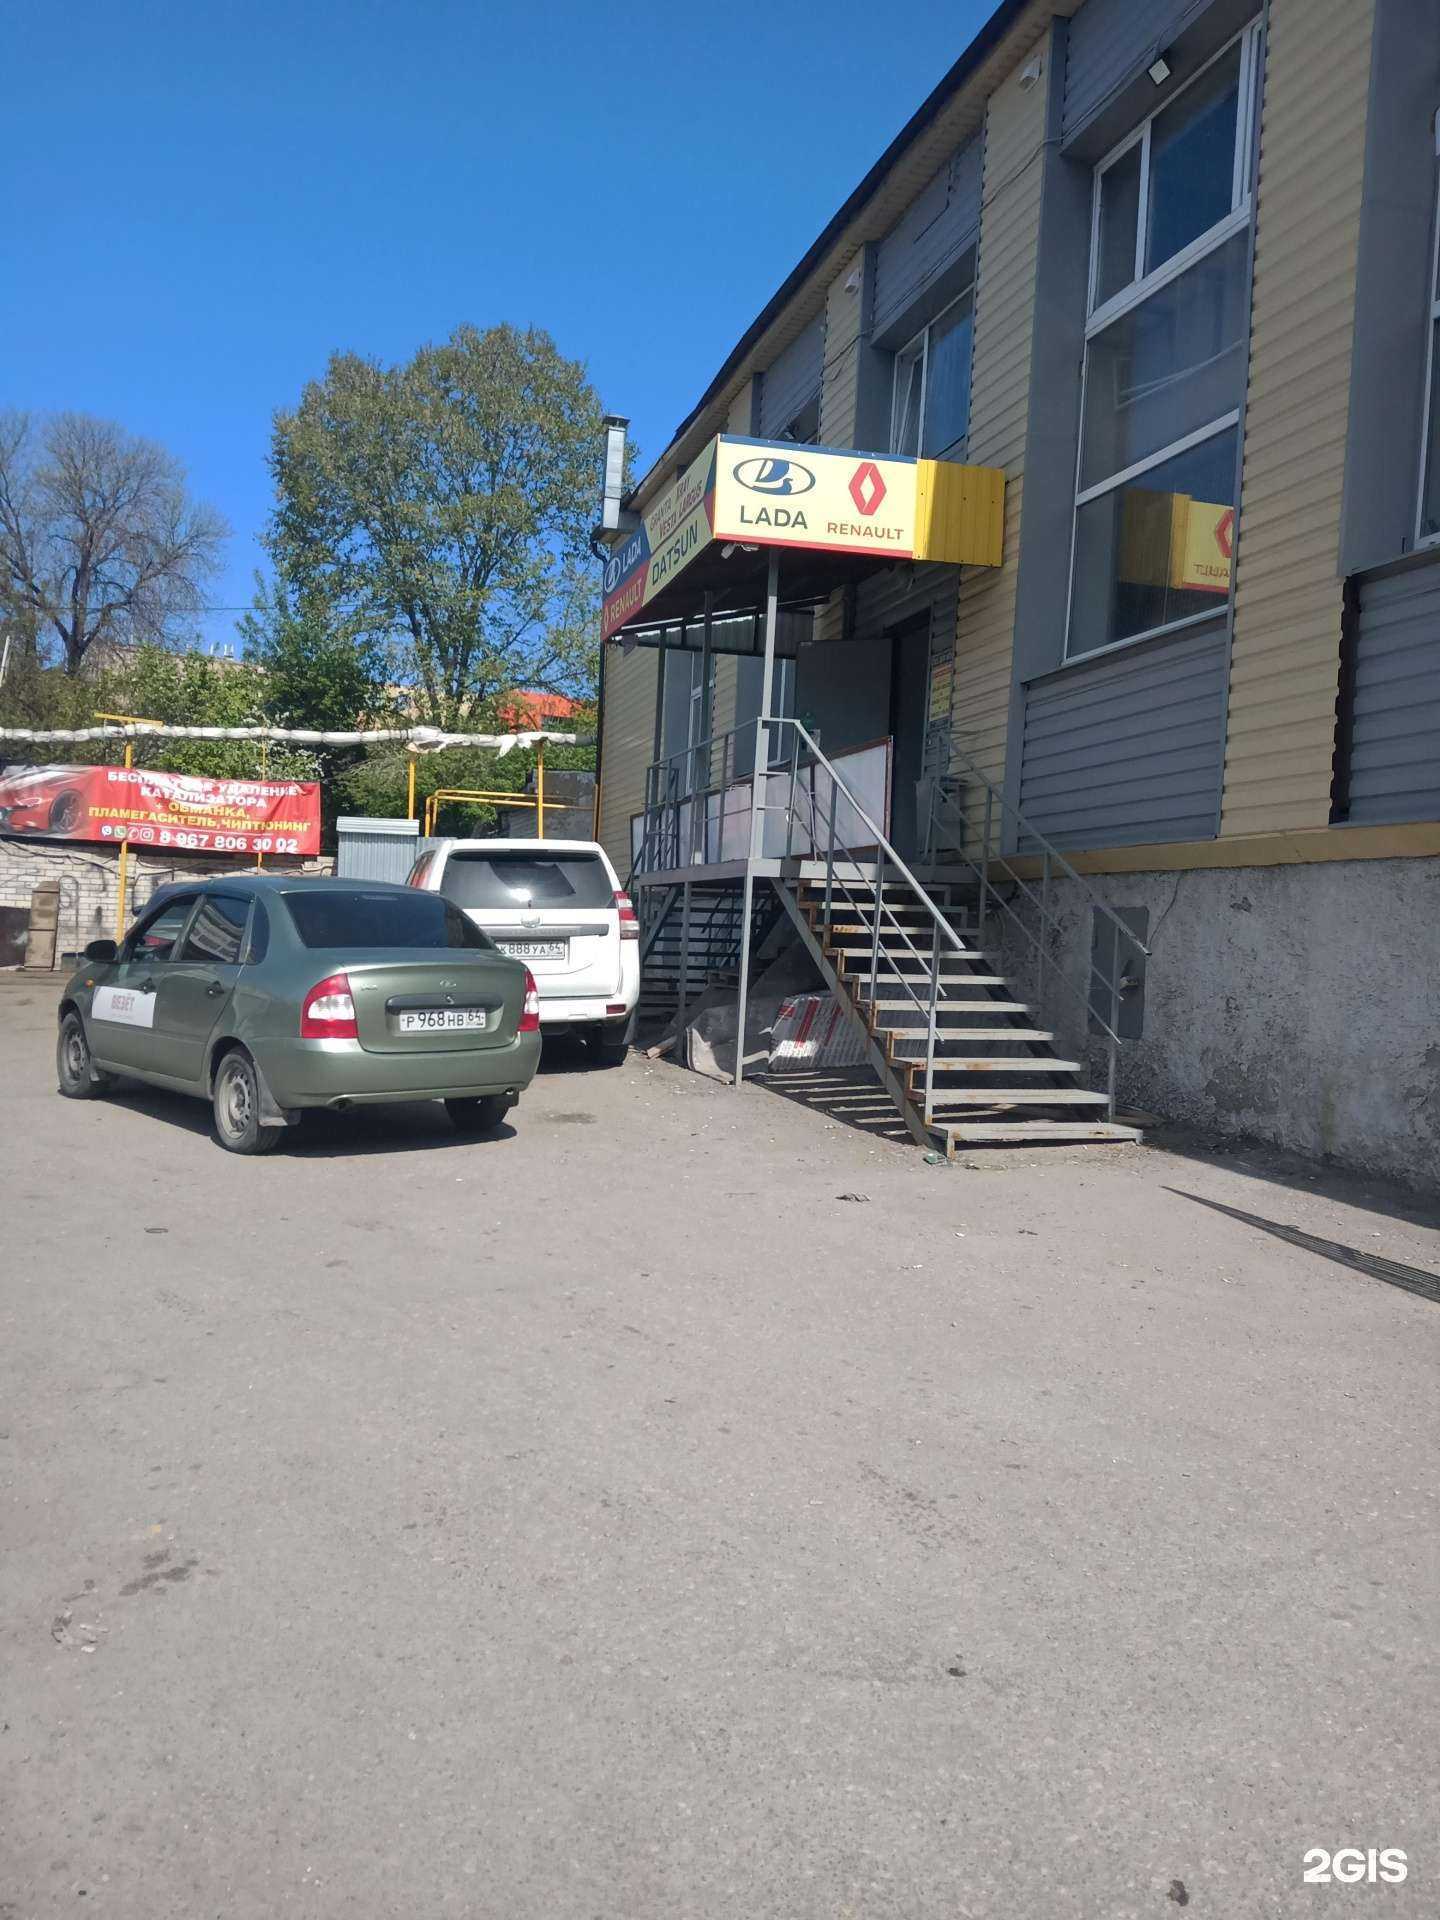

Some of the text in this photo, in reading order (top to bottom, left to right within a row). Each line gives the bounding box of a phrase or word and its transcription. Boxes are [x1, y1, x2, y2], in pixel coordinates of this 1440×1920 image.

[740, 505, 808, 529] LADA
[827, 521, 904, 540] RENAULT
[621, 536, 642, 573] LADA
[652, 520, 699, 586] DATSUN
[609, 578, 643, 622] RENAULT
[140, 786, 268, 809] КАТАЛИЗАТОРА
[214, 835, 247, 850] 806
[252, 837, 272, 851] 30
[275, 836, 298, 854] 02
